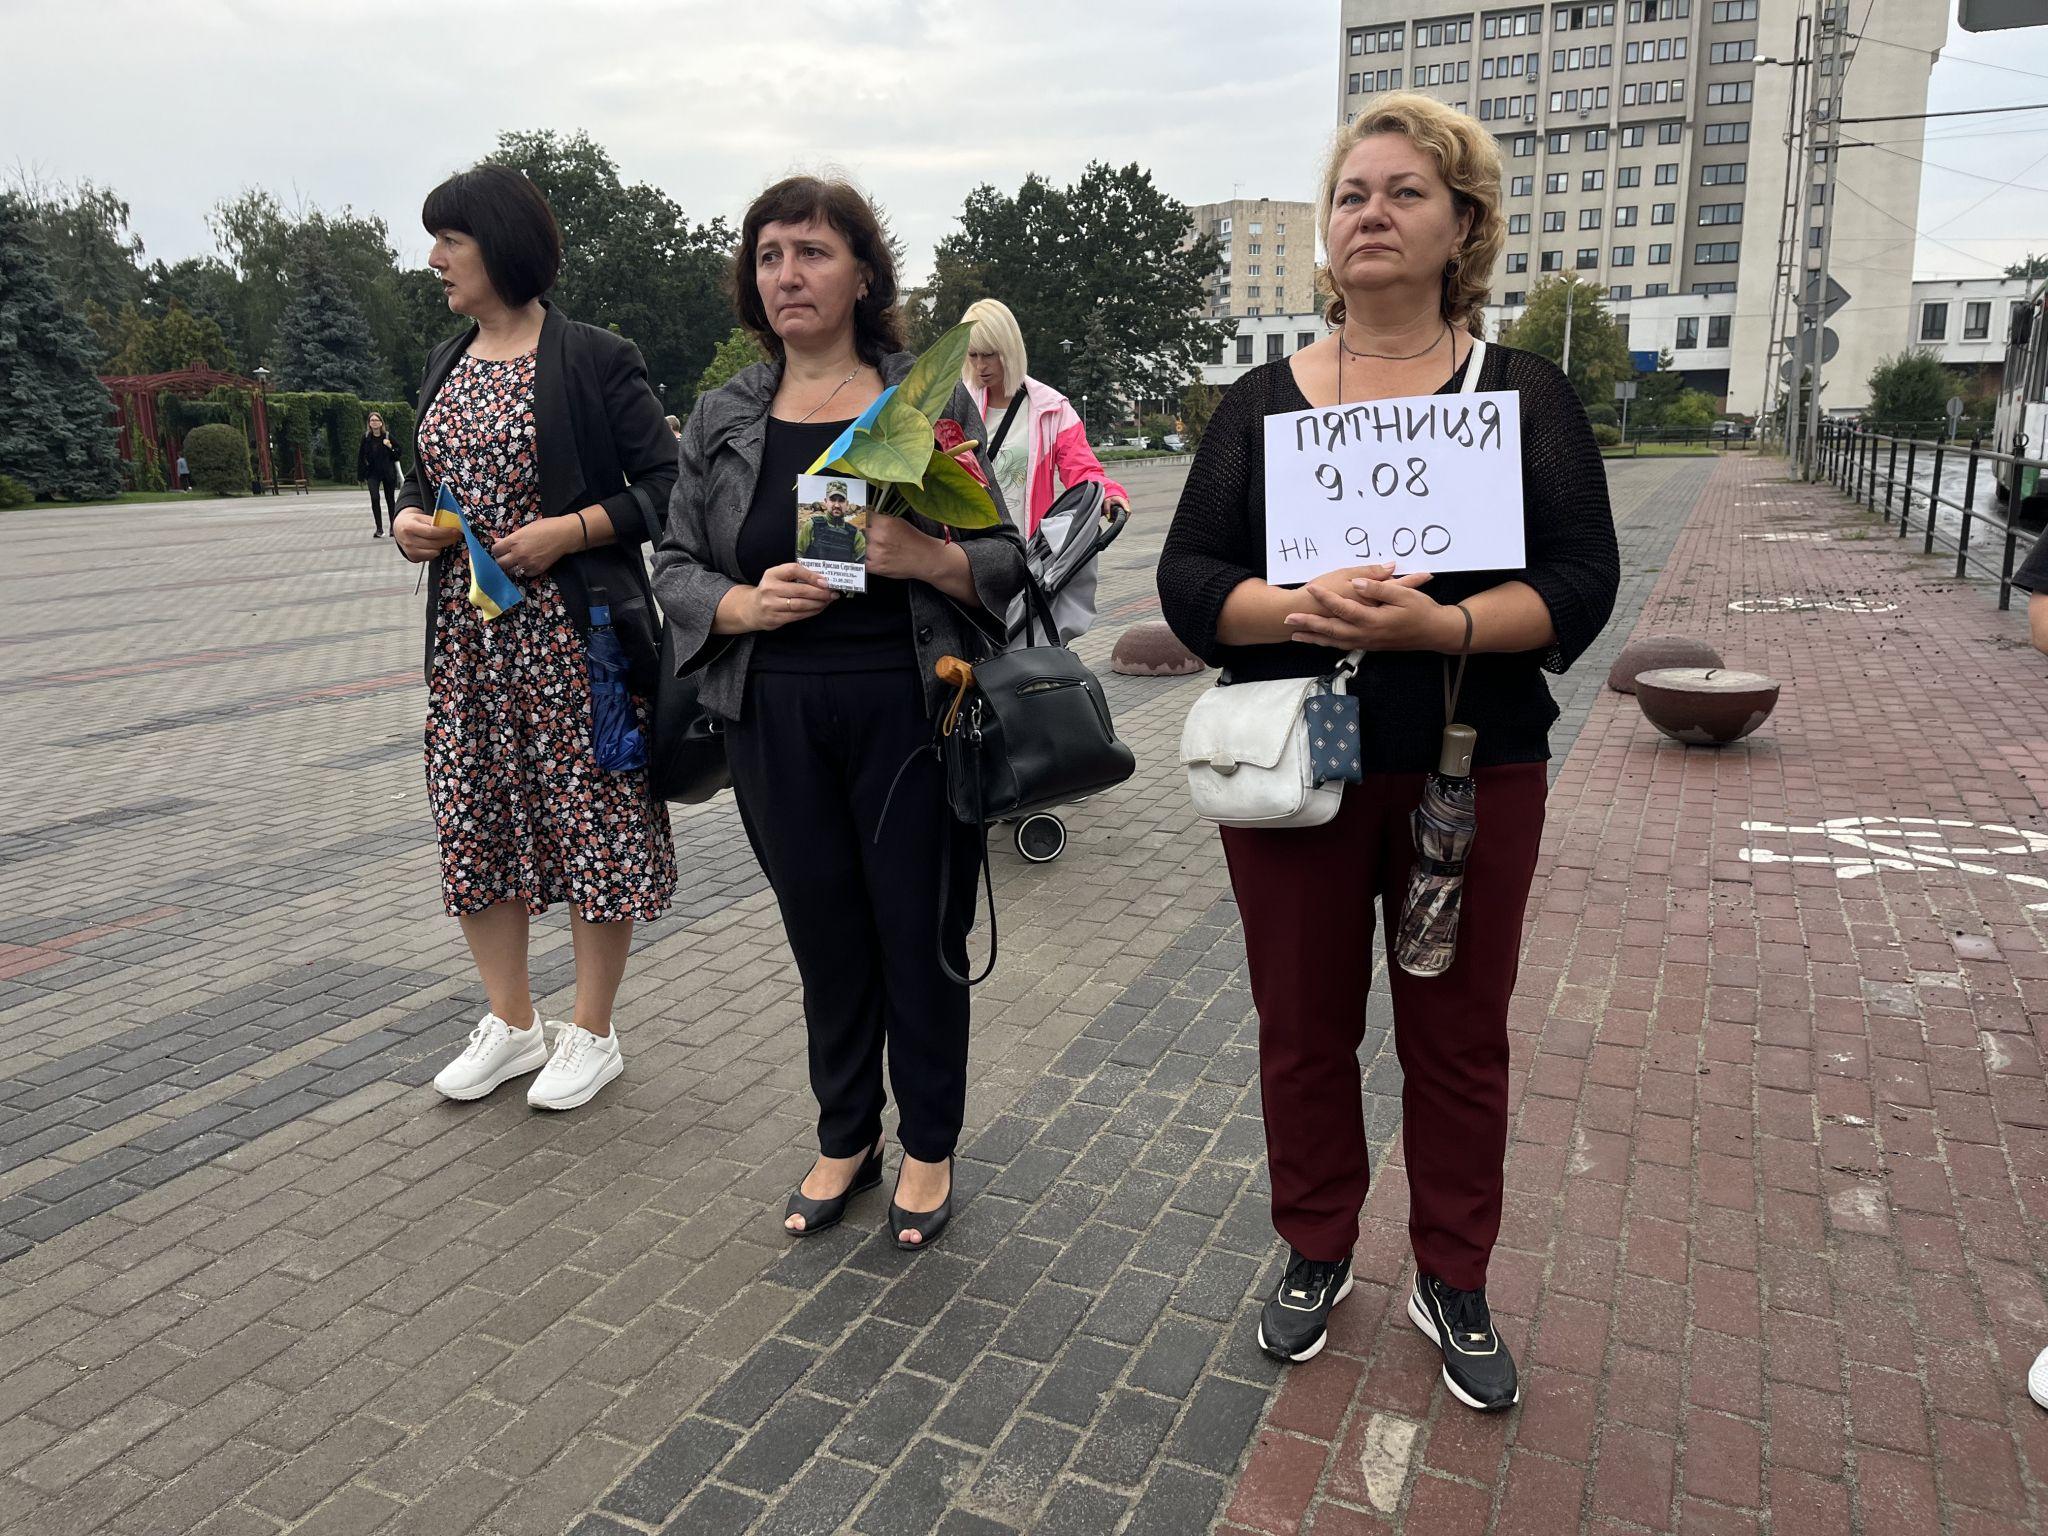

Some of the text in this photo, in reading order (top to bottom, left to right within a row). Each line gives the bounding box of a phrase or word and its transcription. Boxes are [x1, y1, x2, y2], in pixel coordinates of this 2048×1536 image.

[1295, 400, 1502, 453] ПЯТНИЦЯ
[1314, 456, 1430, 501] 9.08
[1278, 524, 1452, 562] НА 9.00
